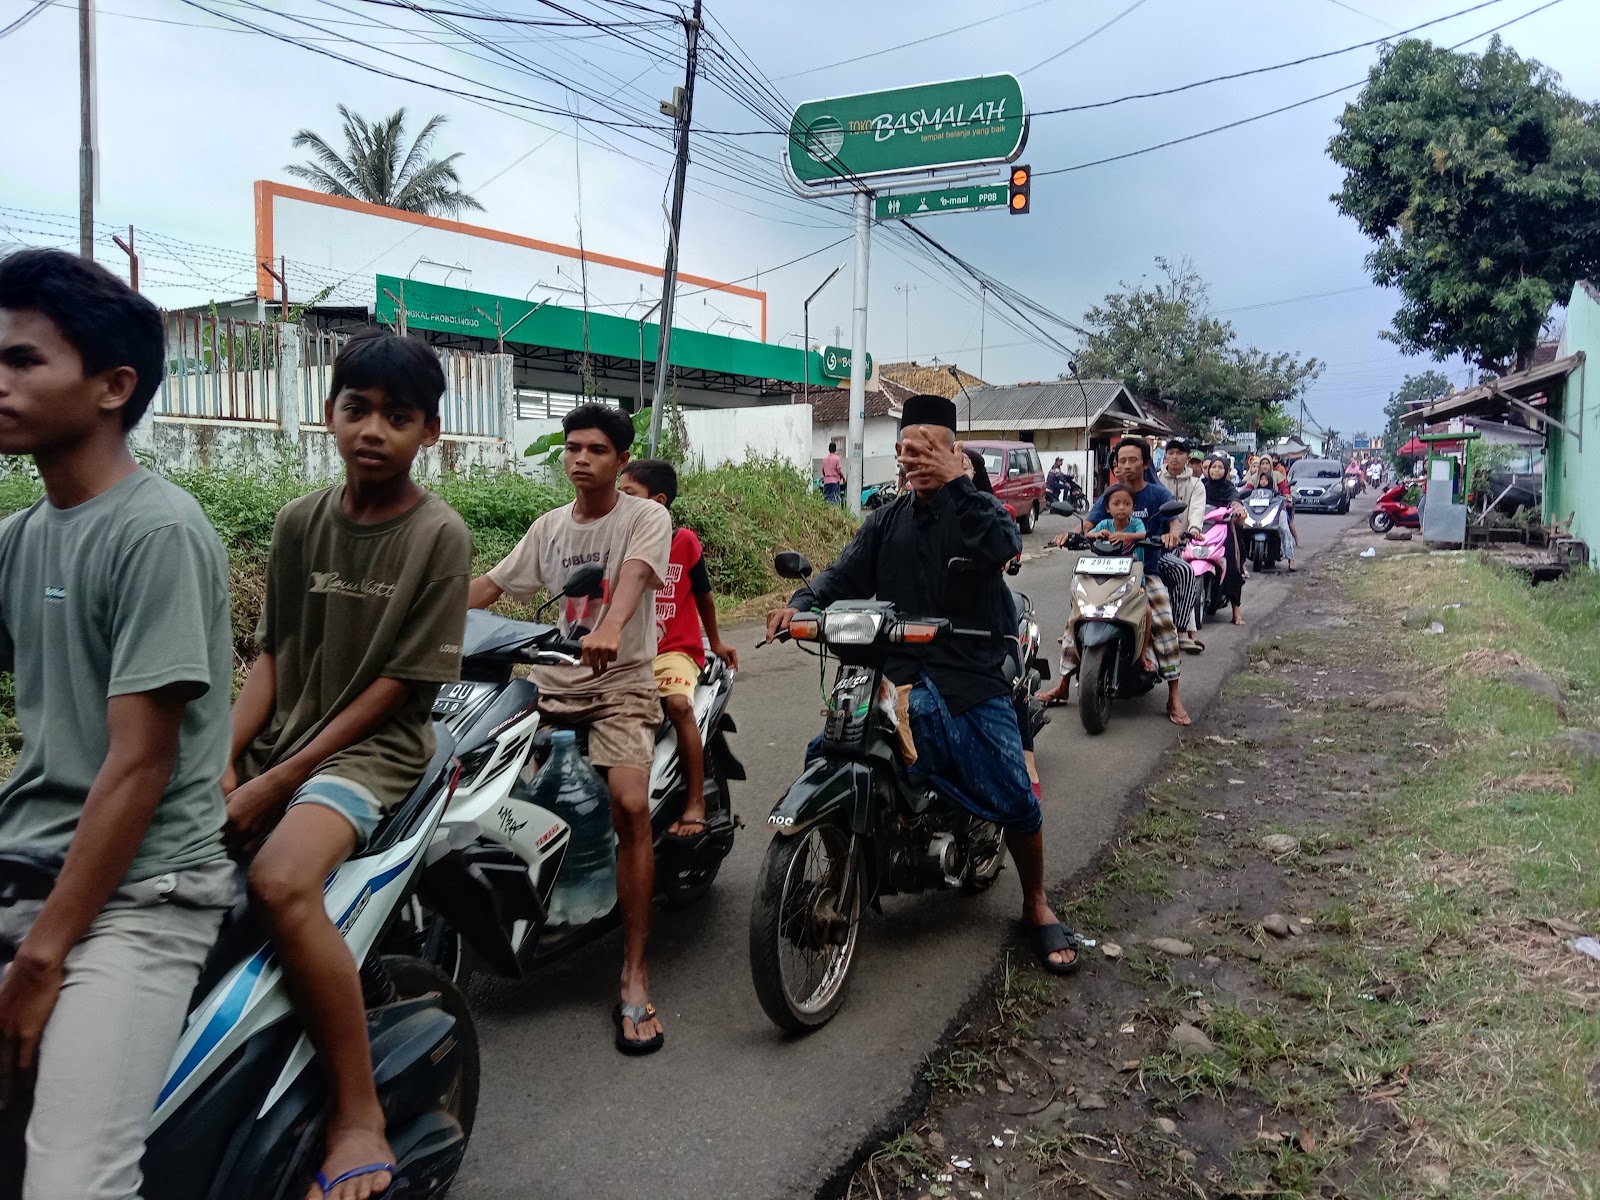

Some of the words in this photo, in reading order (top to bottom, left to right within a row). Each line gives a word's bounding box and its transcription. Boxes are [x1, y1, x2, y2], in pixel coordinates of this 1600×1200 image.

[848, 119, 873, 136] TOKO
[872, 97, 1007, 142] BASMALAH
[920, 133, 945, 143] tempat
[945, 129, 971, 140] belanja
[973, 127, 990, 137] yang
[990, 124, 1006, 133] baik
[978, 192, 998, 203] PPOB
